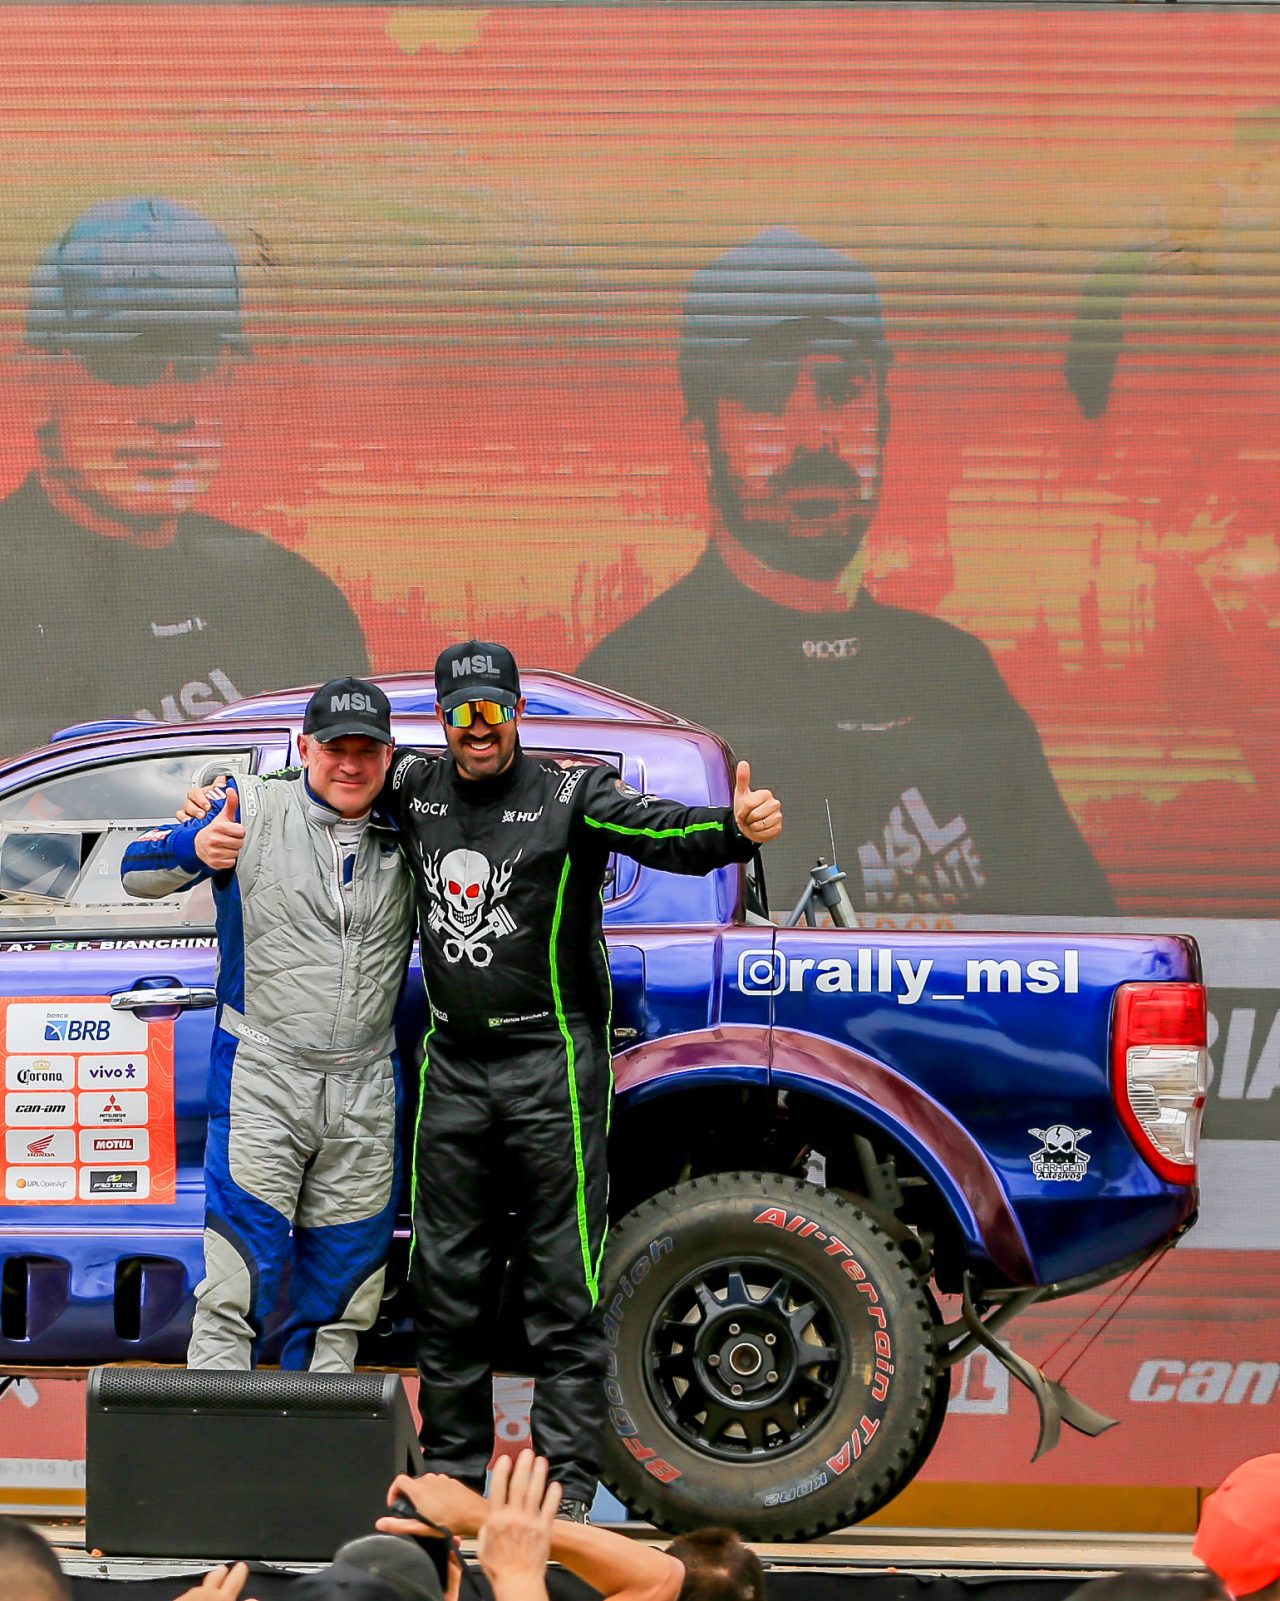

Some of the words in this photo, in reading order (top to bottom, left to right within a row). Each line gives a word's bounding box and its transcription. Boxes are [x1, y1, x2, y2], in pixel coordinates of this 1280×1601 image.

[452, 655, 500, 678] MSL
[330, 692, 377, 714] MSL
[67, 1020, 111, 1041] BRB
[235, 1023, 270, 1045] sparco
[17, 1068, 63, 1085] Corona
[90, 1065, 123, 1078] vivo
[15, 1104, 67, 1113] can-am
[96, 1140, 132, 1149] MOTUL
[1035, 1163, 1084, 1172] GARAGEM
[753, 1207, 894, 1402] All-Terrain
[825, 1415, 880, 1475] T/A
